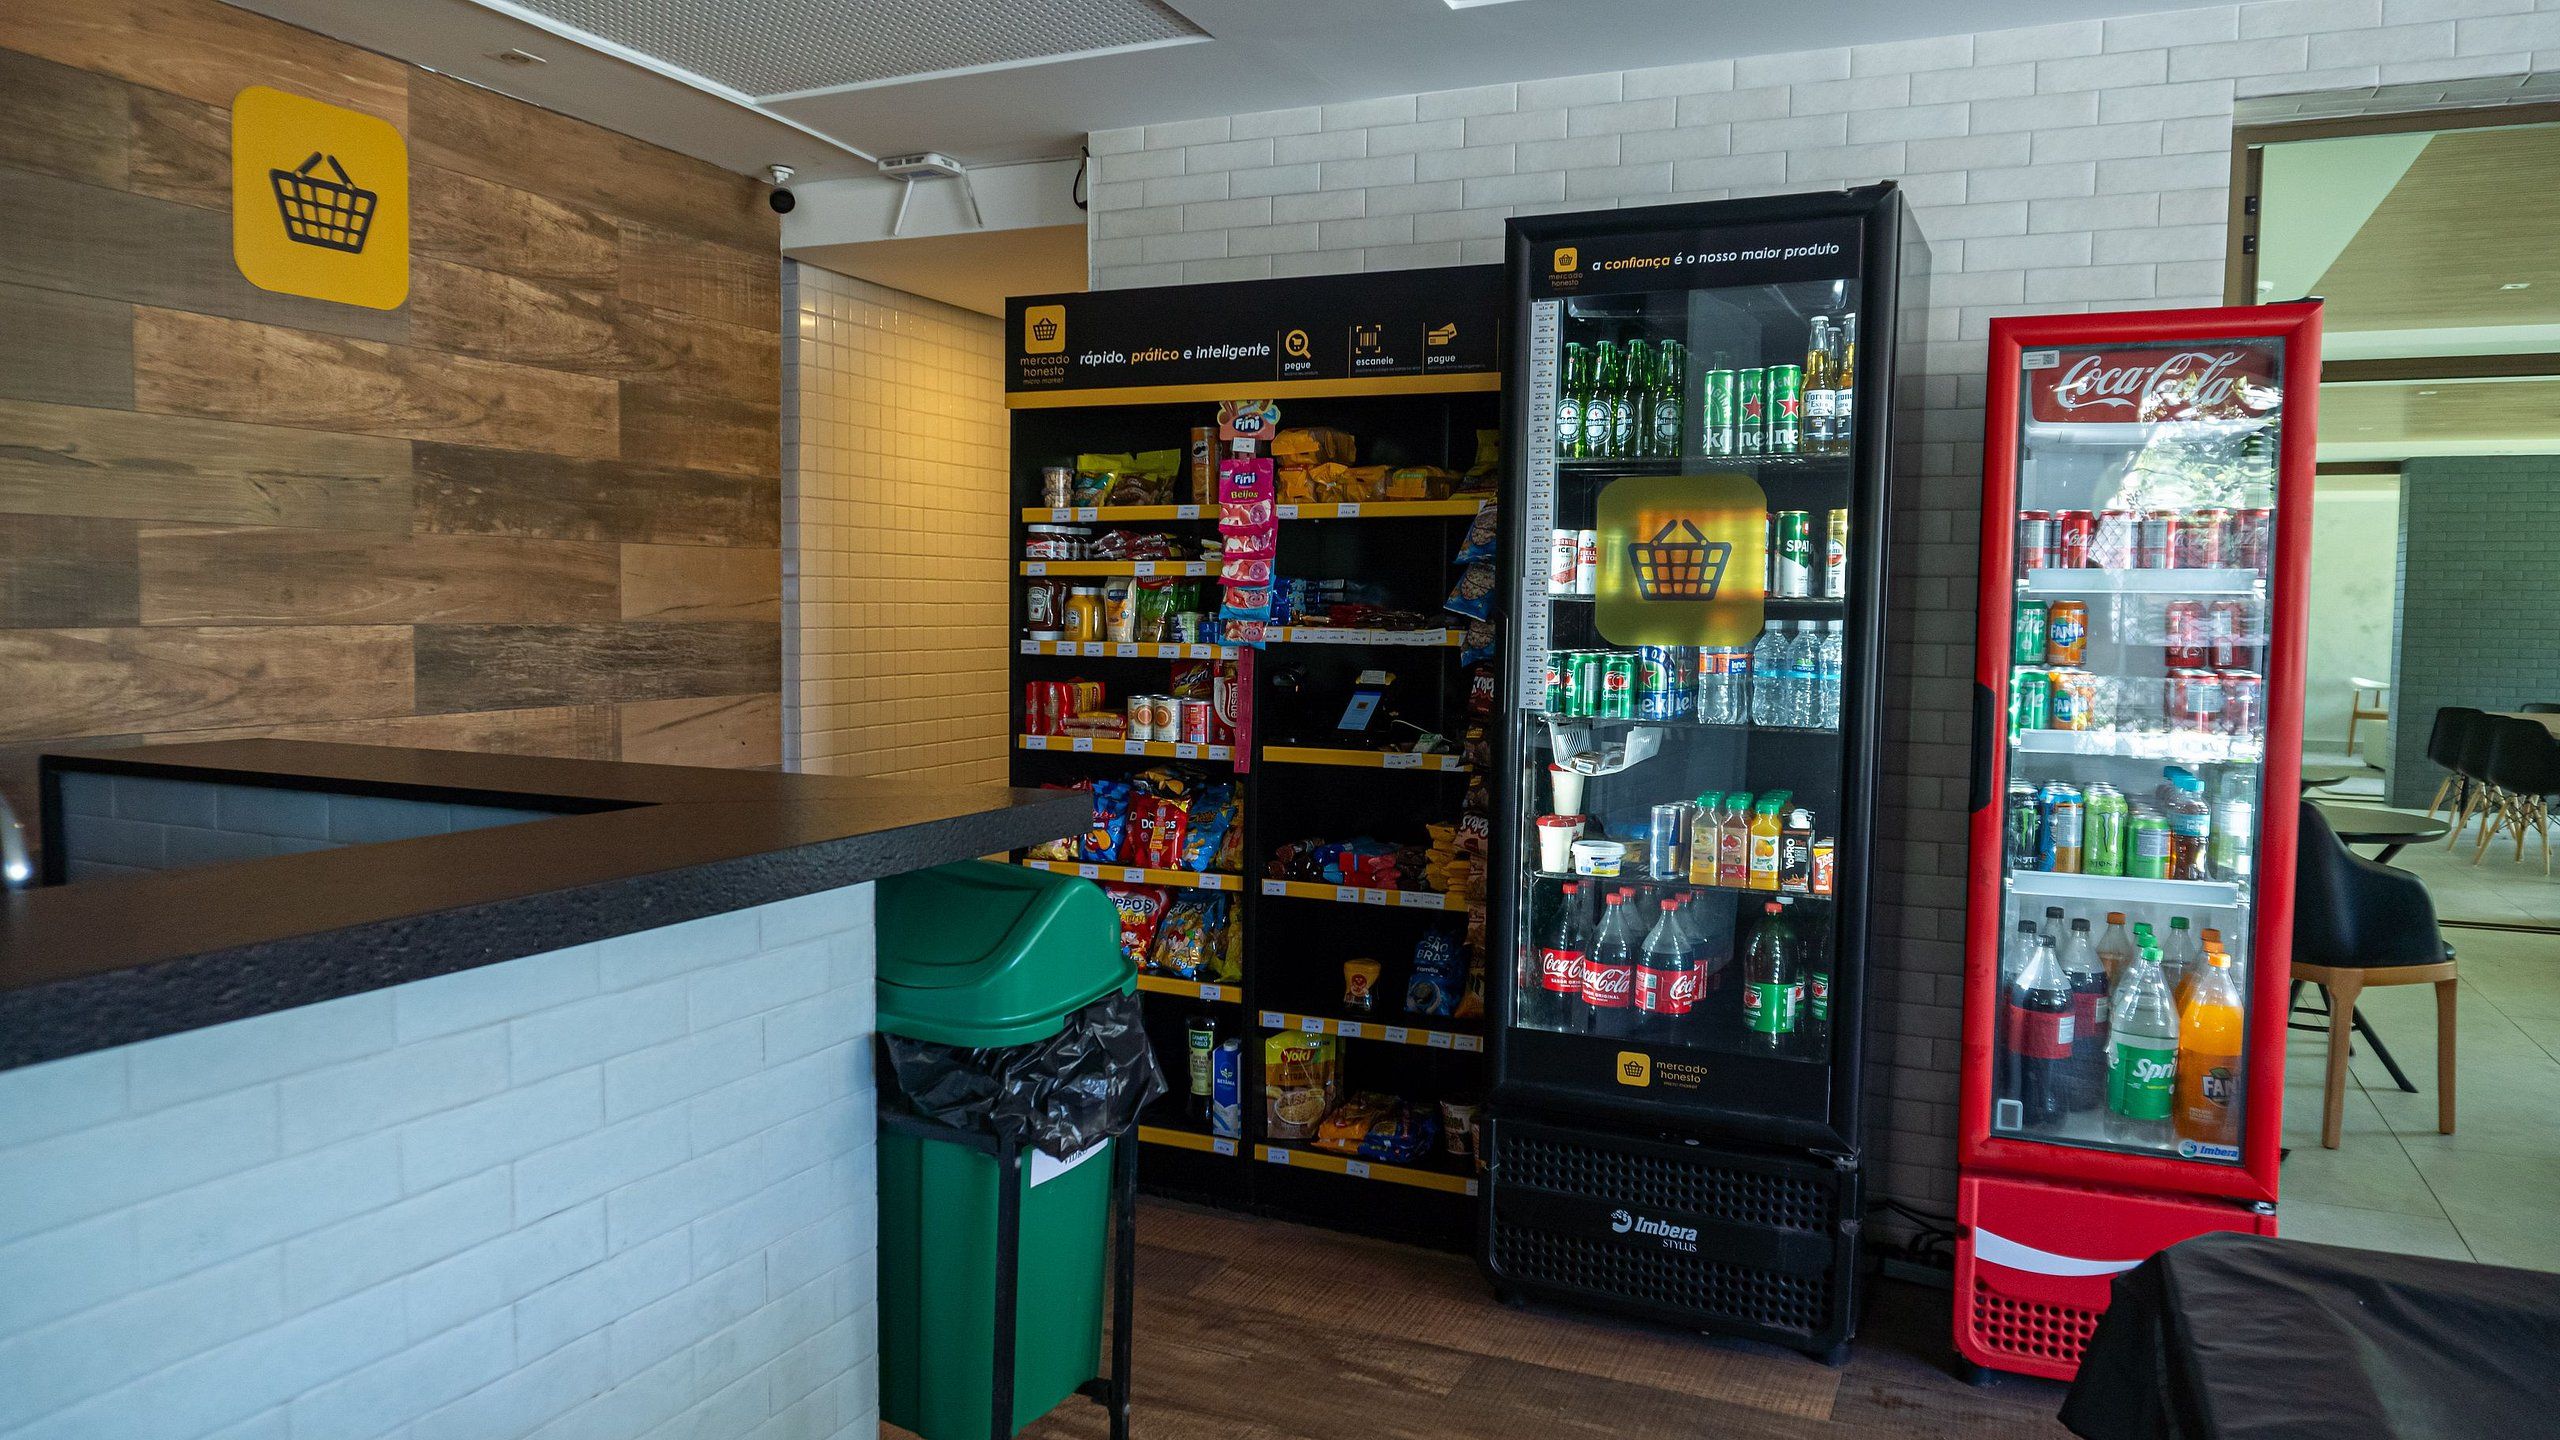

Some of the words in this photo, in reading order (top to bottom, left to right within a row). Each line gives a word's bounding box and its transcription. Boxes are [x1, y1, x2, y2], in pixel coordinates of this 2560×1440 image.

[1592, 260, 1602, 271] a
[1604, 254, 1671, 271] confiança
[1673, 252, 1683, 265] é
[1686, 255, 1695, 265] o
[1698, 250, 1738, 264] nosso
[1741, 246, 1782, 260] maior
[1783, 242, 1840, 260] produto
[1548, 271, 1584, 281] mercado
[1551, 278, 1579, 288] honesto
[1080, 348, 1127, 367] rápido,
[1130, 345, 1180, 366] prático
[1183, 349, 1193, 360] e
[1196, 340, 1270, 362] inteligente
[1427, 354, 1456, 366] pague
[1020, 354, 1070, 367] mercado
[1284, 360, 1312, 372] pegue
[1023, 365, 1065, 377] honesto
[1234, 472, 1256, 485] Fini
[1231, 490, 1259, 500] Beijos
[1141, 818, 1176, 829] Doos
[1785, 838, 1795, 870] YoPRO
[1594, 992, 1621, 1000] ORIGINAL
[1656, 1060, 1709, 1075] mercado
[1660, 1070, 1702, 1084] honesto
[2200, 1145, 2239, 1158] Imbera
[1634, 1216, 1698, 1242] Imbera
[1662, 1239, 1697, 1253] STYLUS
